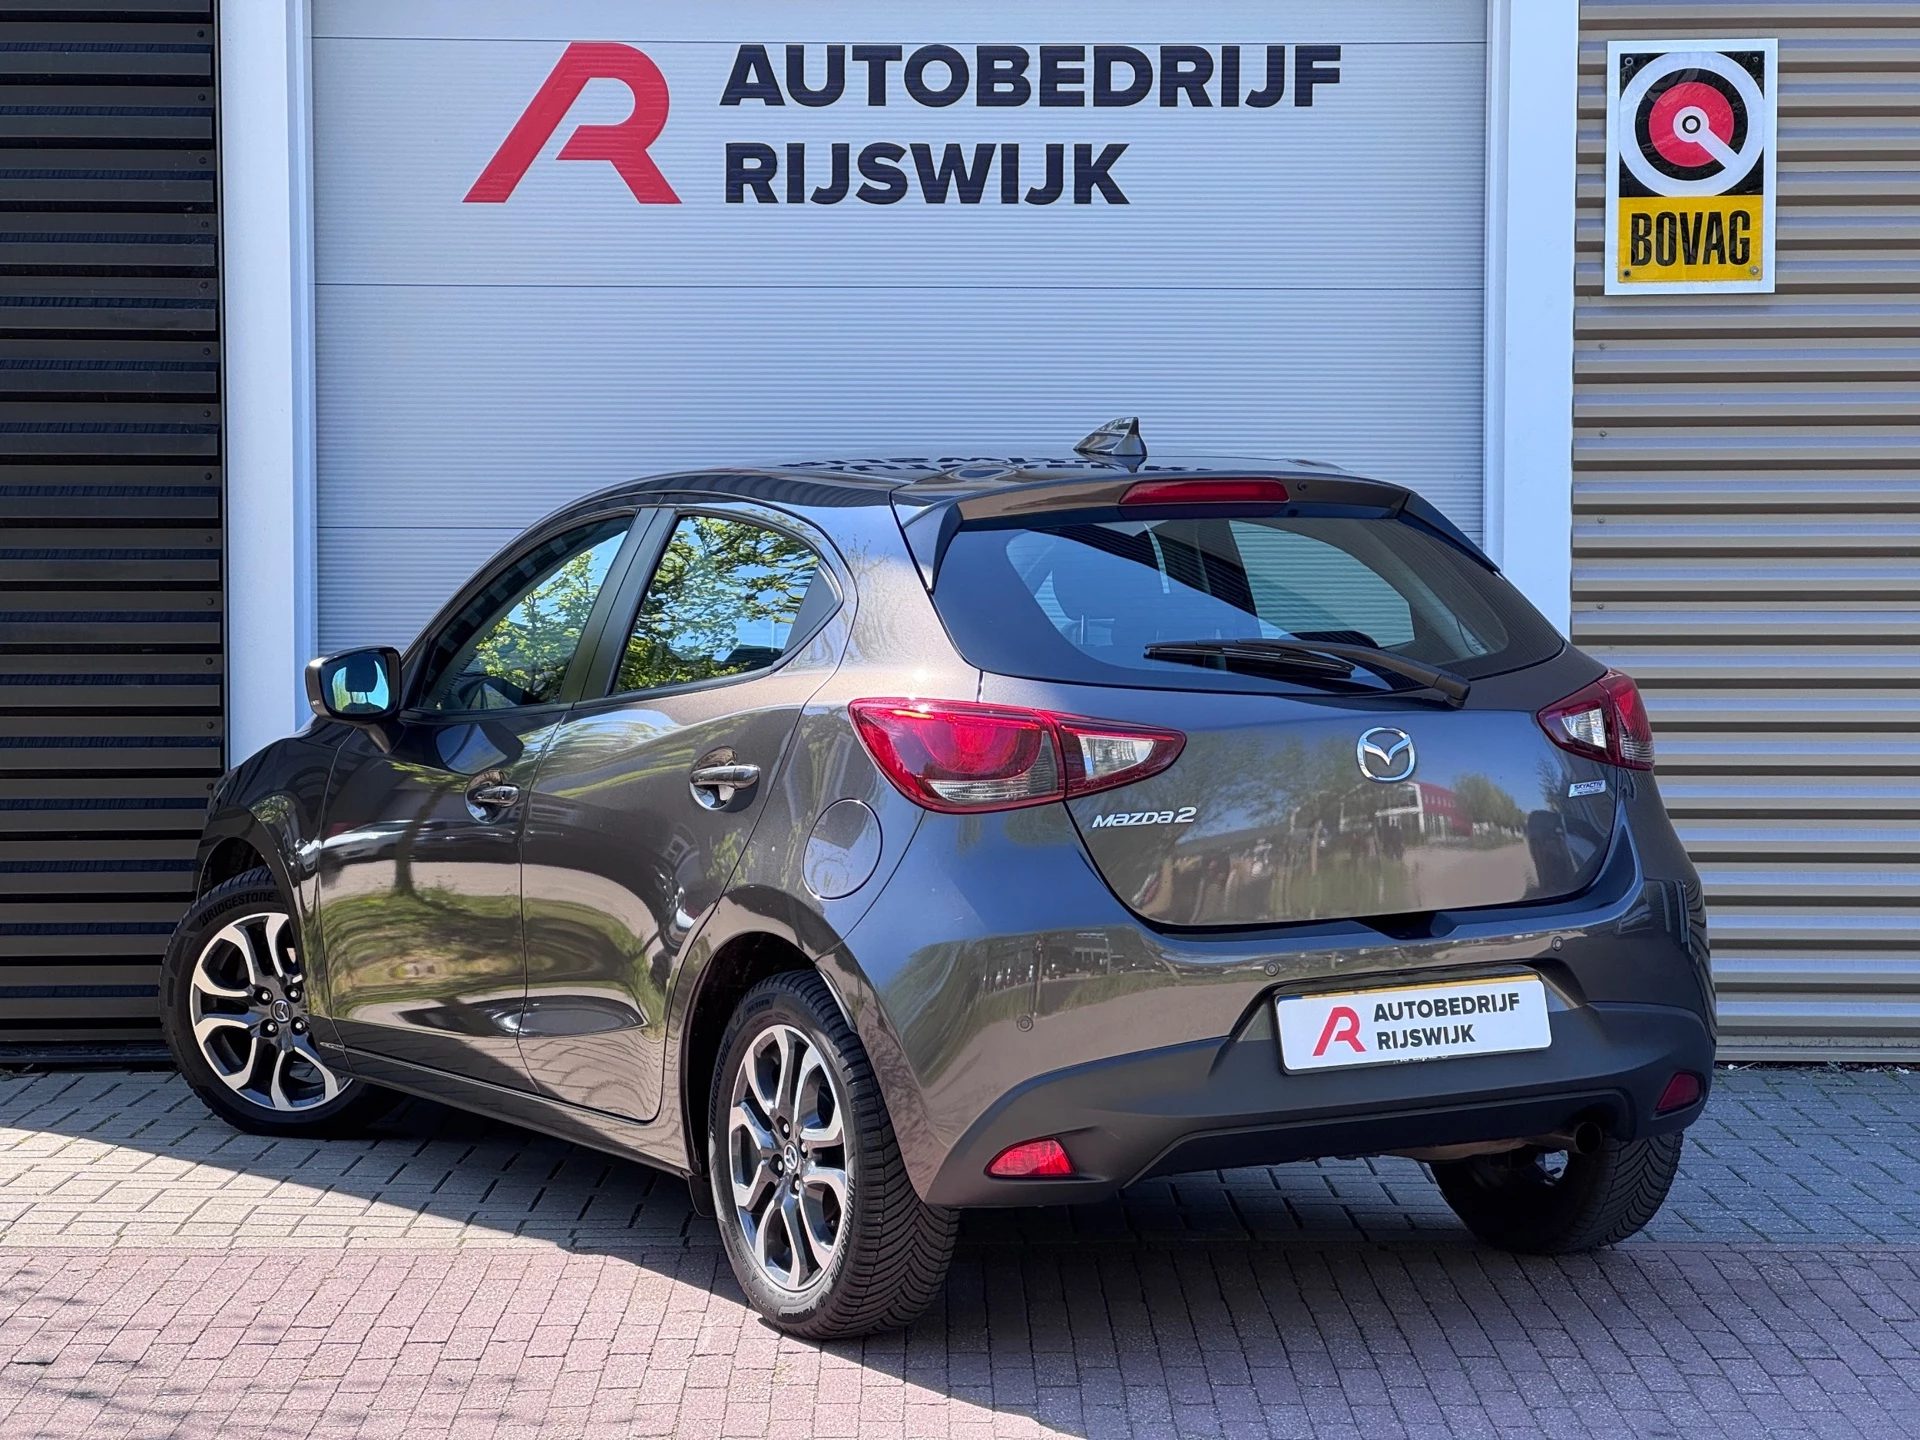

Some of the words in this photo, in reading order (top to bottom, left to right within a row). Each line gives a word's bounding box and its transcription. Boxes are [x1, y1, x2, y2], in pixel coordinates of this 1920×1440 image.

[719, 44, 1341, 108] AUTOBEDRIJF
[725, 142, 1130, 205] RIJSWIJK
[1631, 210, 1750, 266] BOVAG
[201, 891, 275, 928] BRIDGESTONE
[1373, 992, 1520, 1022] AUTOBEDRIJF
[1376, 1024, 1476, 1050] RIJSWIJK
